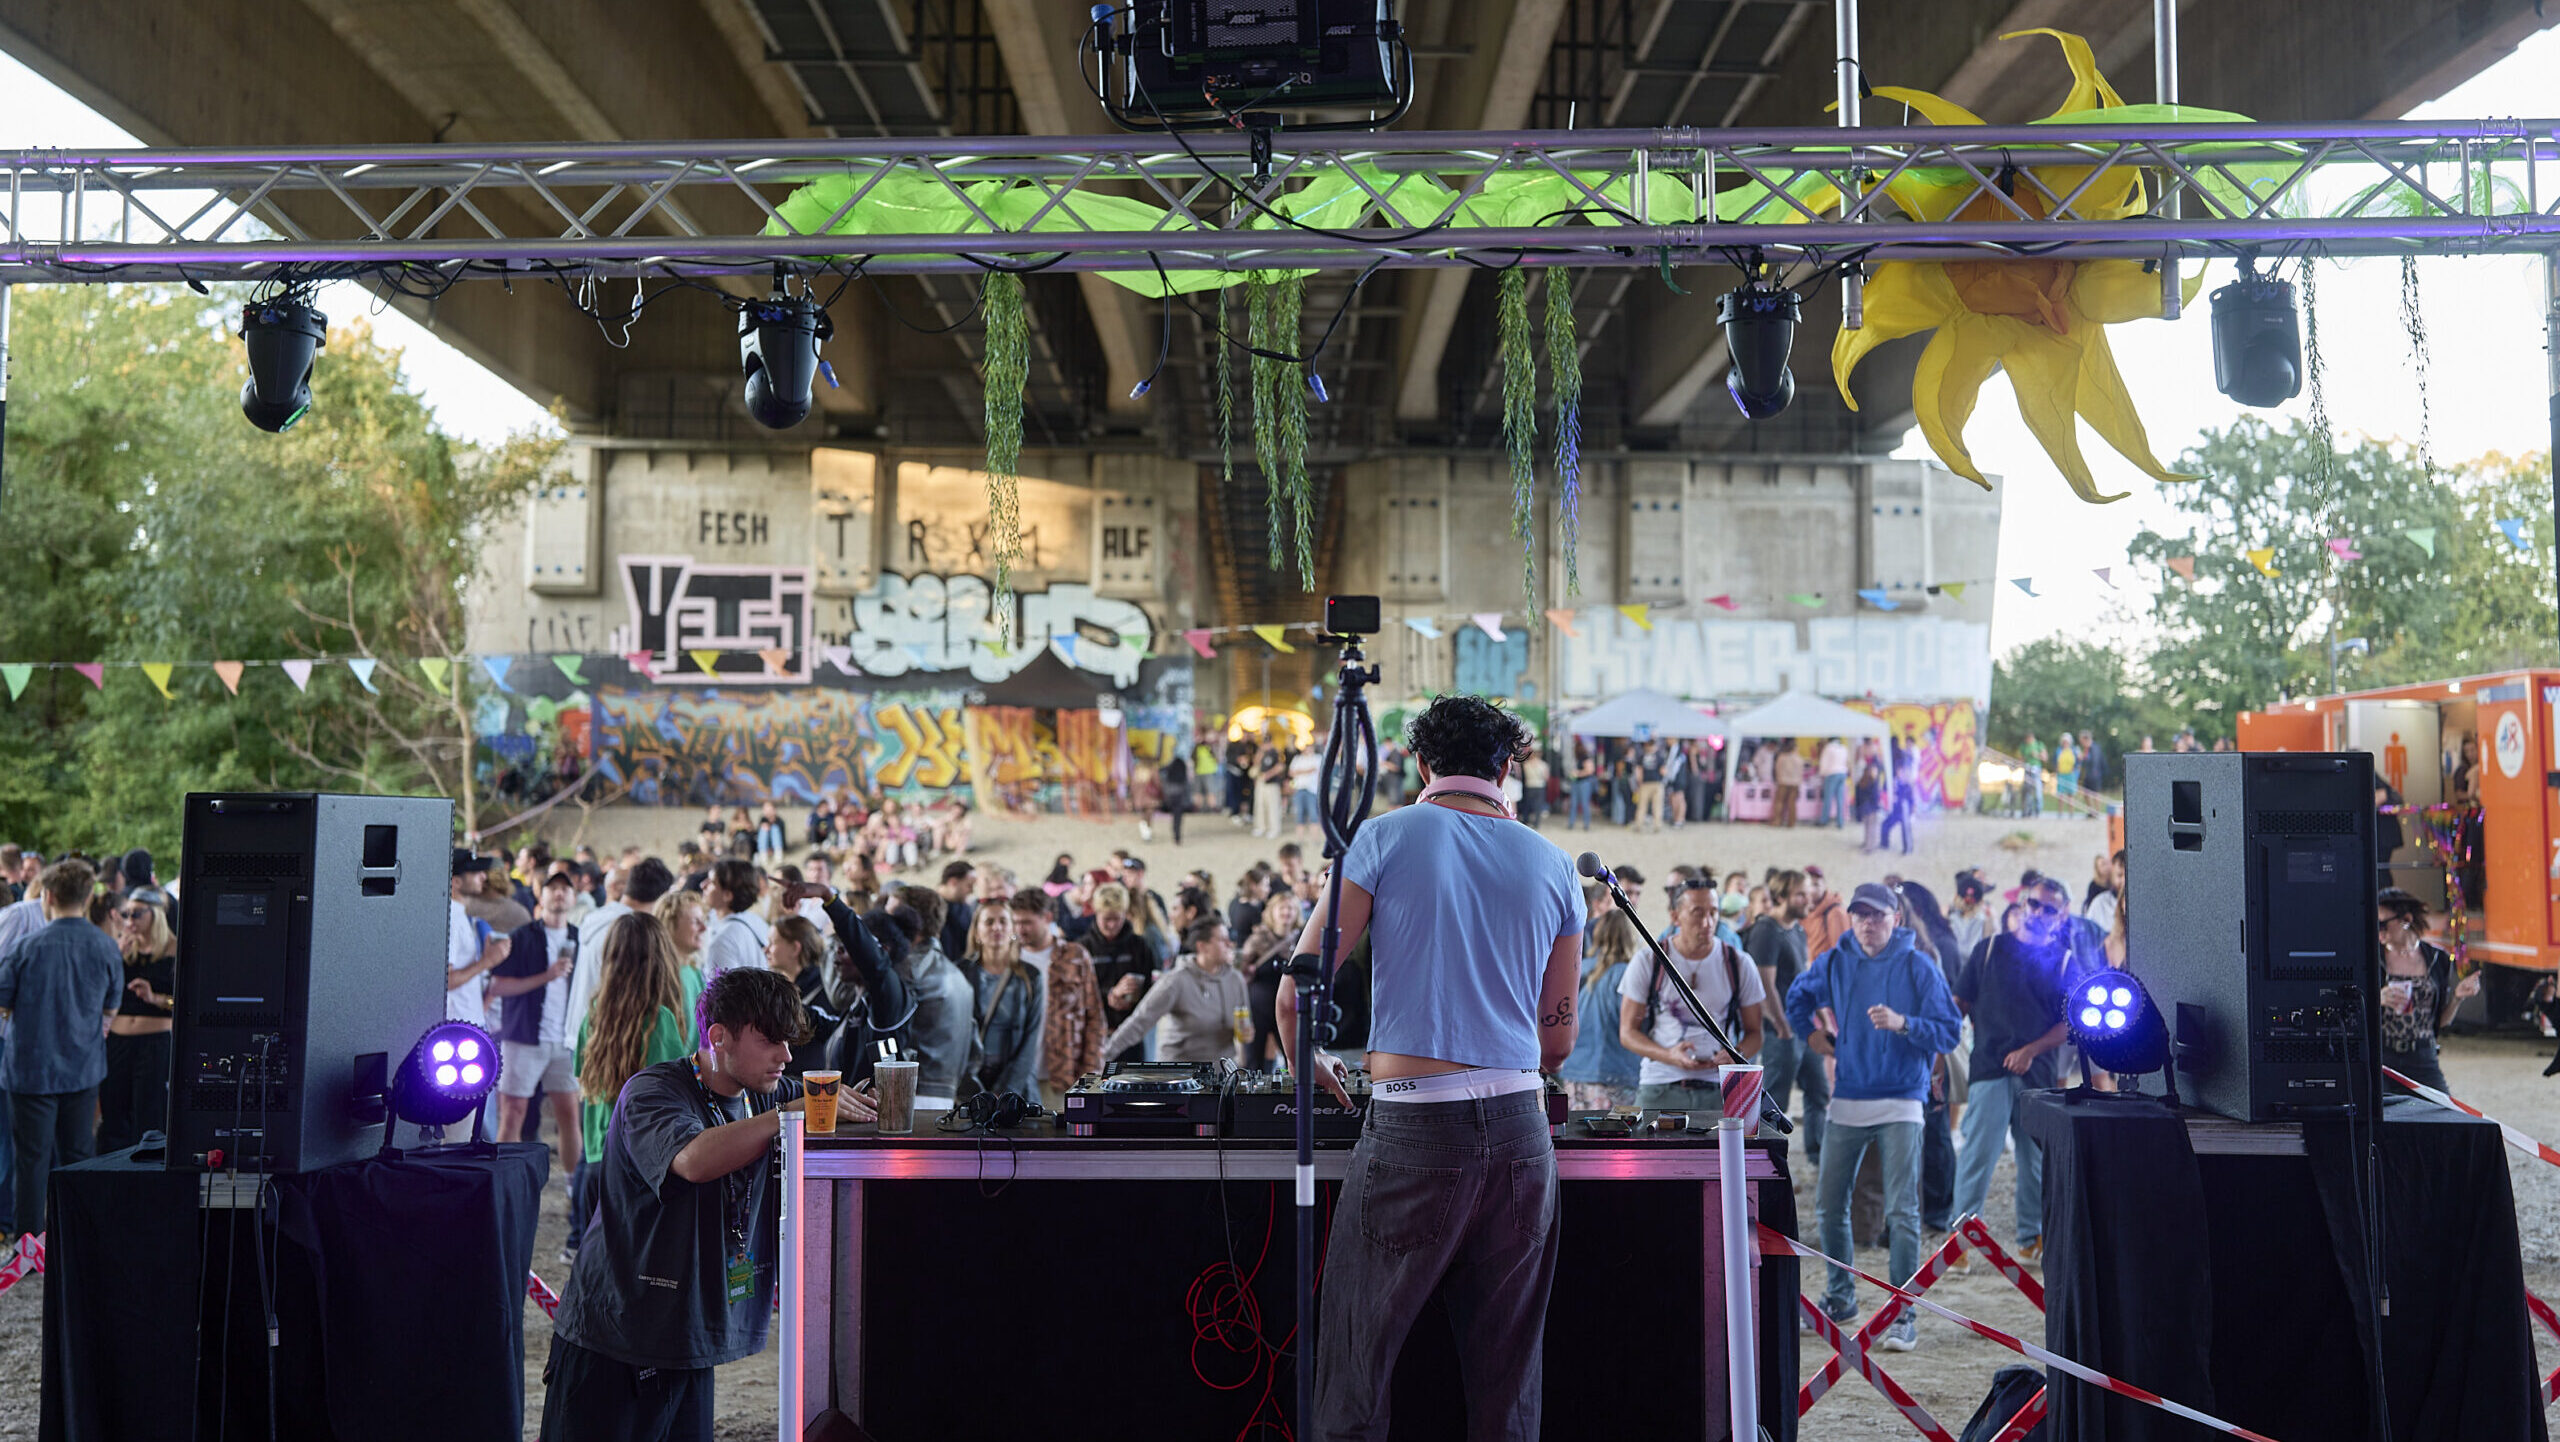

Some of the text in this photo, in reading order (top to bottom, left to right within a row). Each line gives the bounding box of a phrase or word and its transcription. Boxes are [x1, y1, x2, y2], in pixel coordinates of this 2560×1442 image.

[1229, 14, 1257, 25] ARRI
[1326, 25, 1355, 36] ARRI
[698, 509, 768, 545] FESH
[1102, 526, 1151, 560] ALF
[1386, 1081, 1417, 1093] BOSS
[1273, 1103, 1341, 1115] Pioeer
